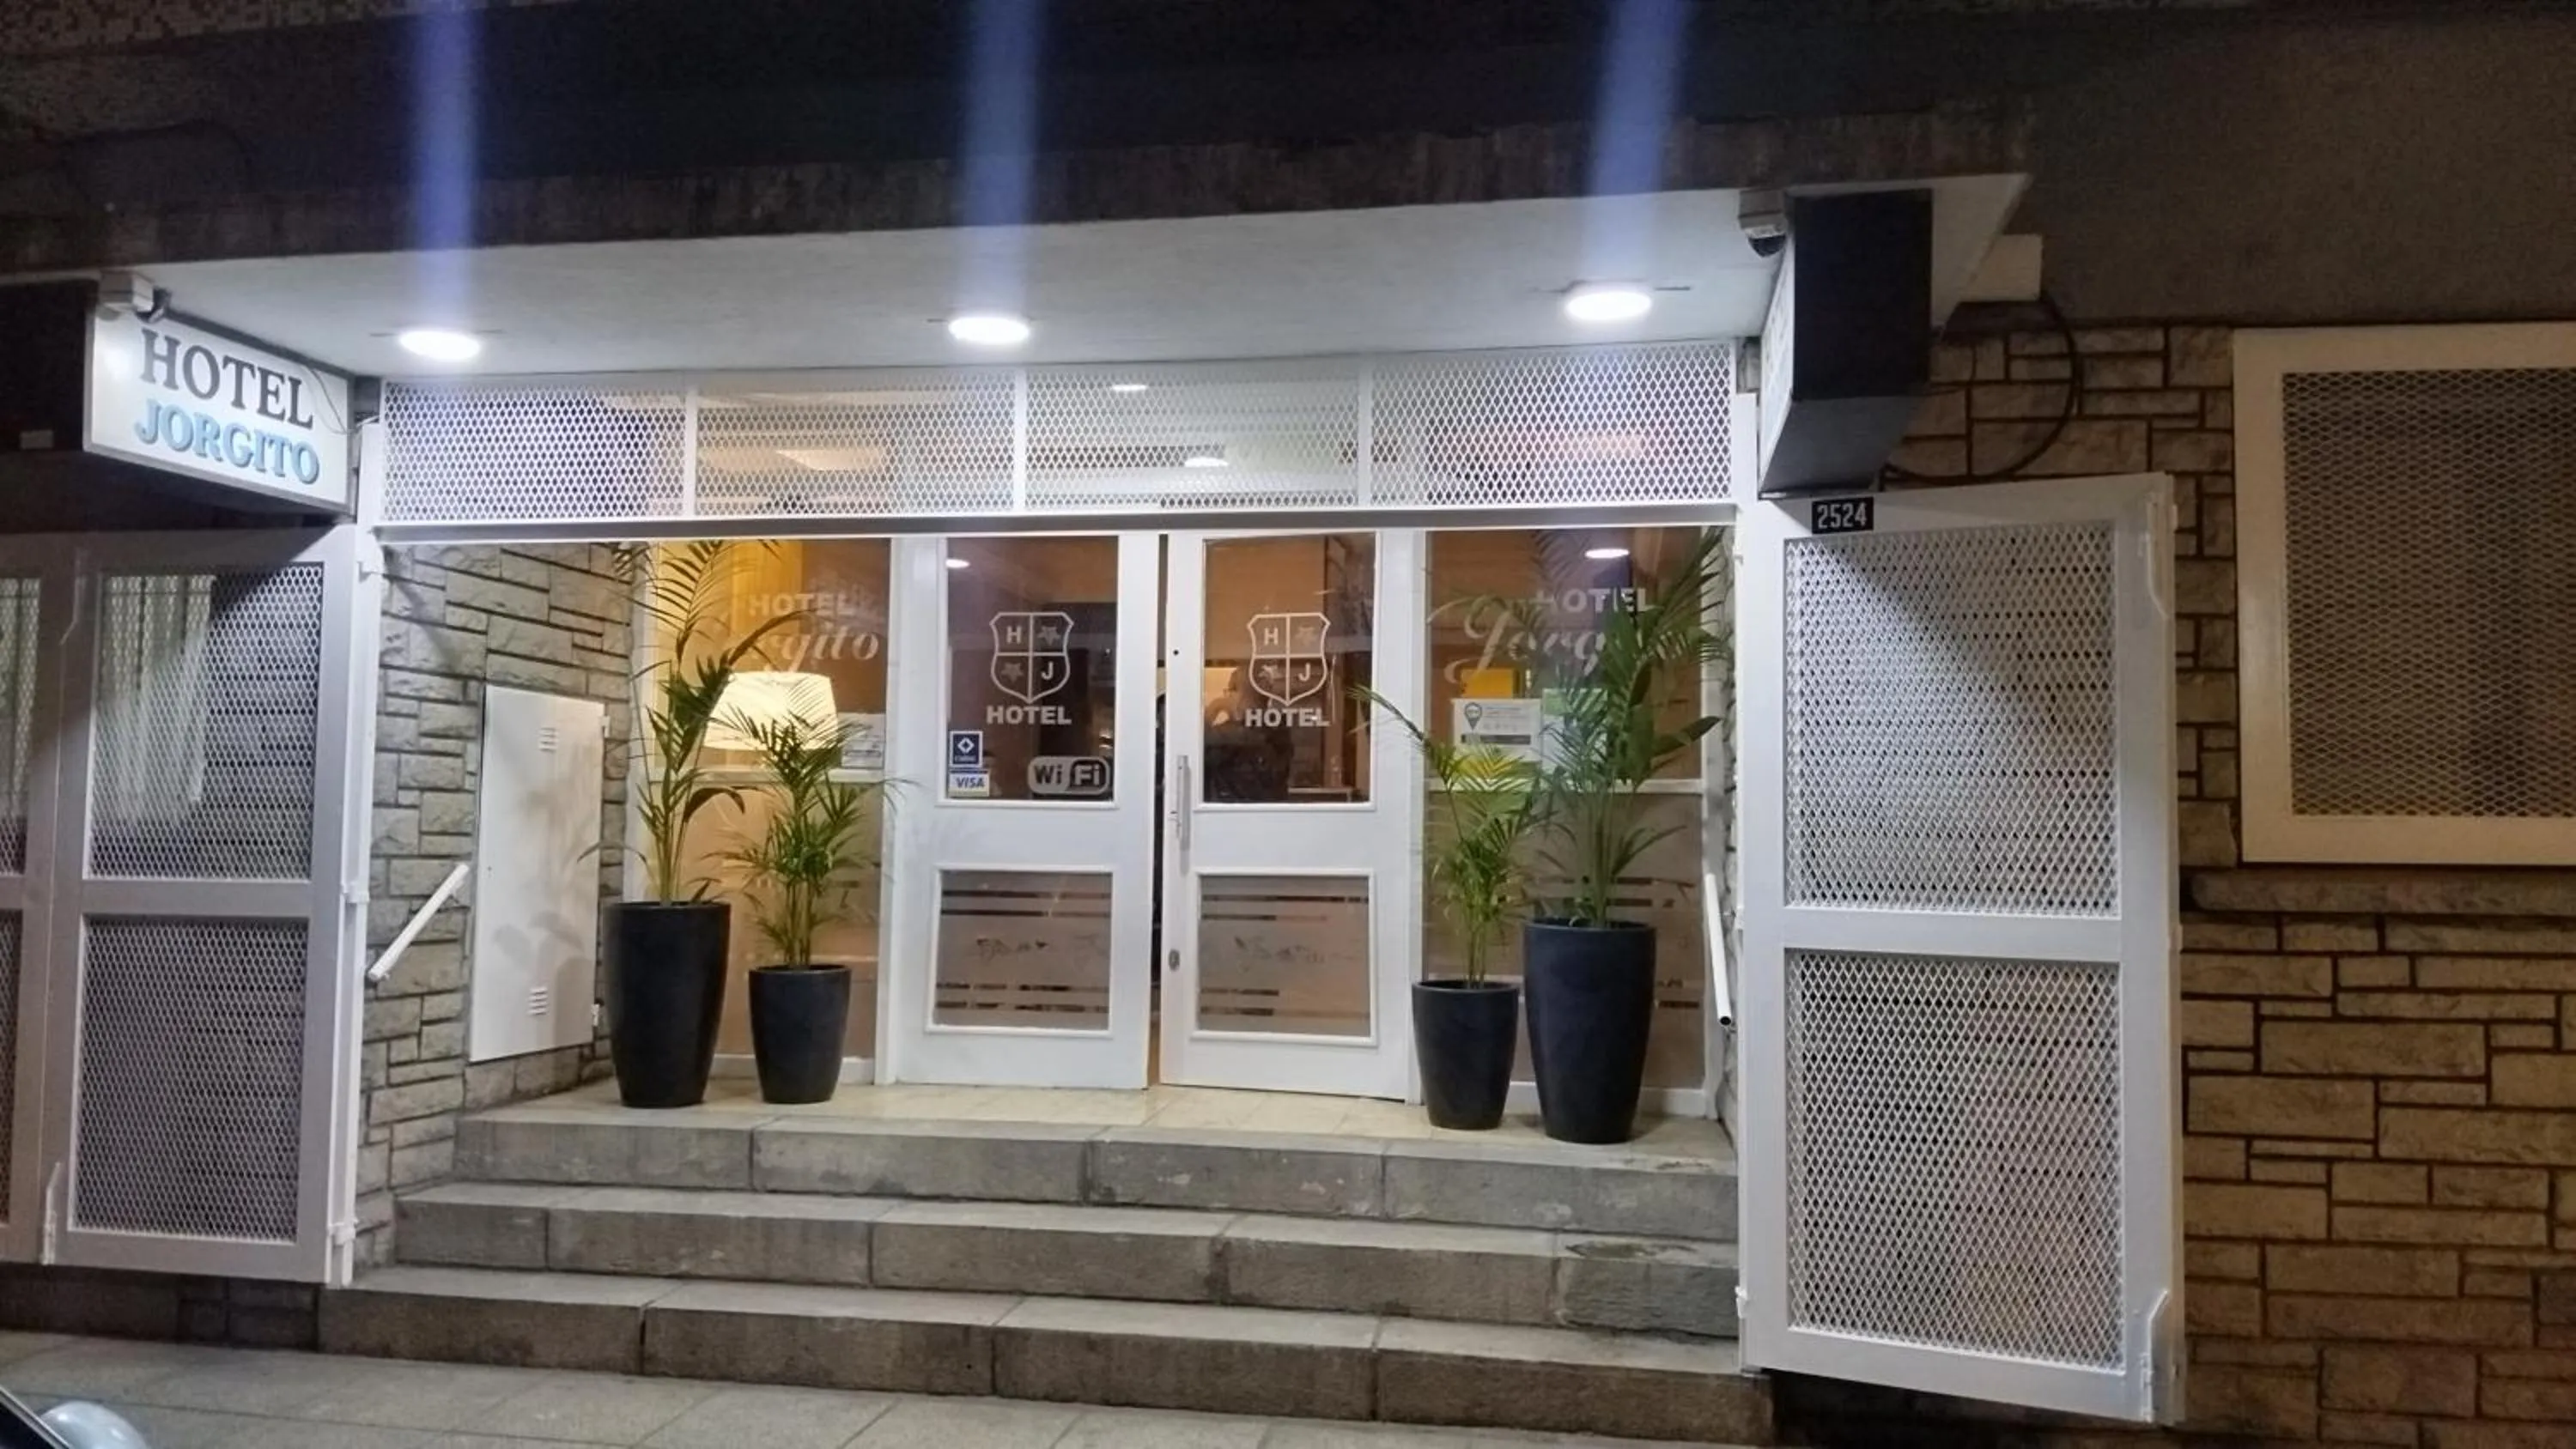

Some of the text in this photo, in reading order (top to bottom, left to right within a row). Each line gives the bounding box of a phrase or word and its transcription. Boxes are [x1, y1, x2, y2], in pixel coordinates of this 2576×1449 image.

[140, 327, 313, 430] HOTEL
[134, 399, 320, 484] JORGITO
[1816, 502, 1868, 529] 2524
[749, 592, 858, 616] HOTEL
[1006, 626, 1022, 645] H
[1264, 627, 1279, 646] H
[1041, 662, 1054, 680] J
[1297, 663, 1311, 682] J
[987, 706, 1072, 724] HOTEL
[1246, 708, 1331, 727] HOTEL
[956, 777, 985, 788] VISA
